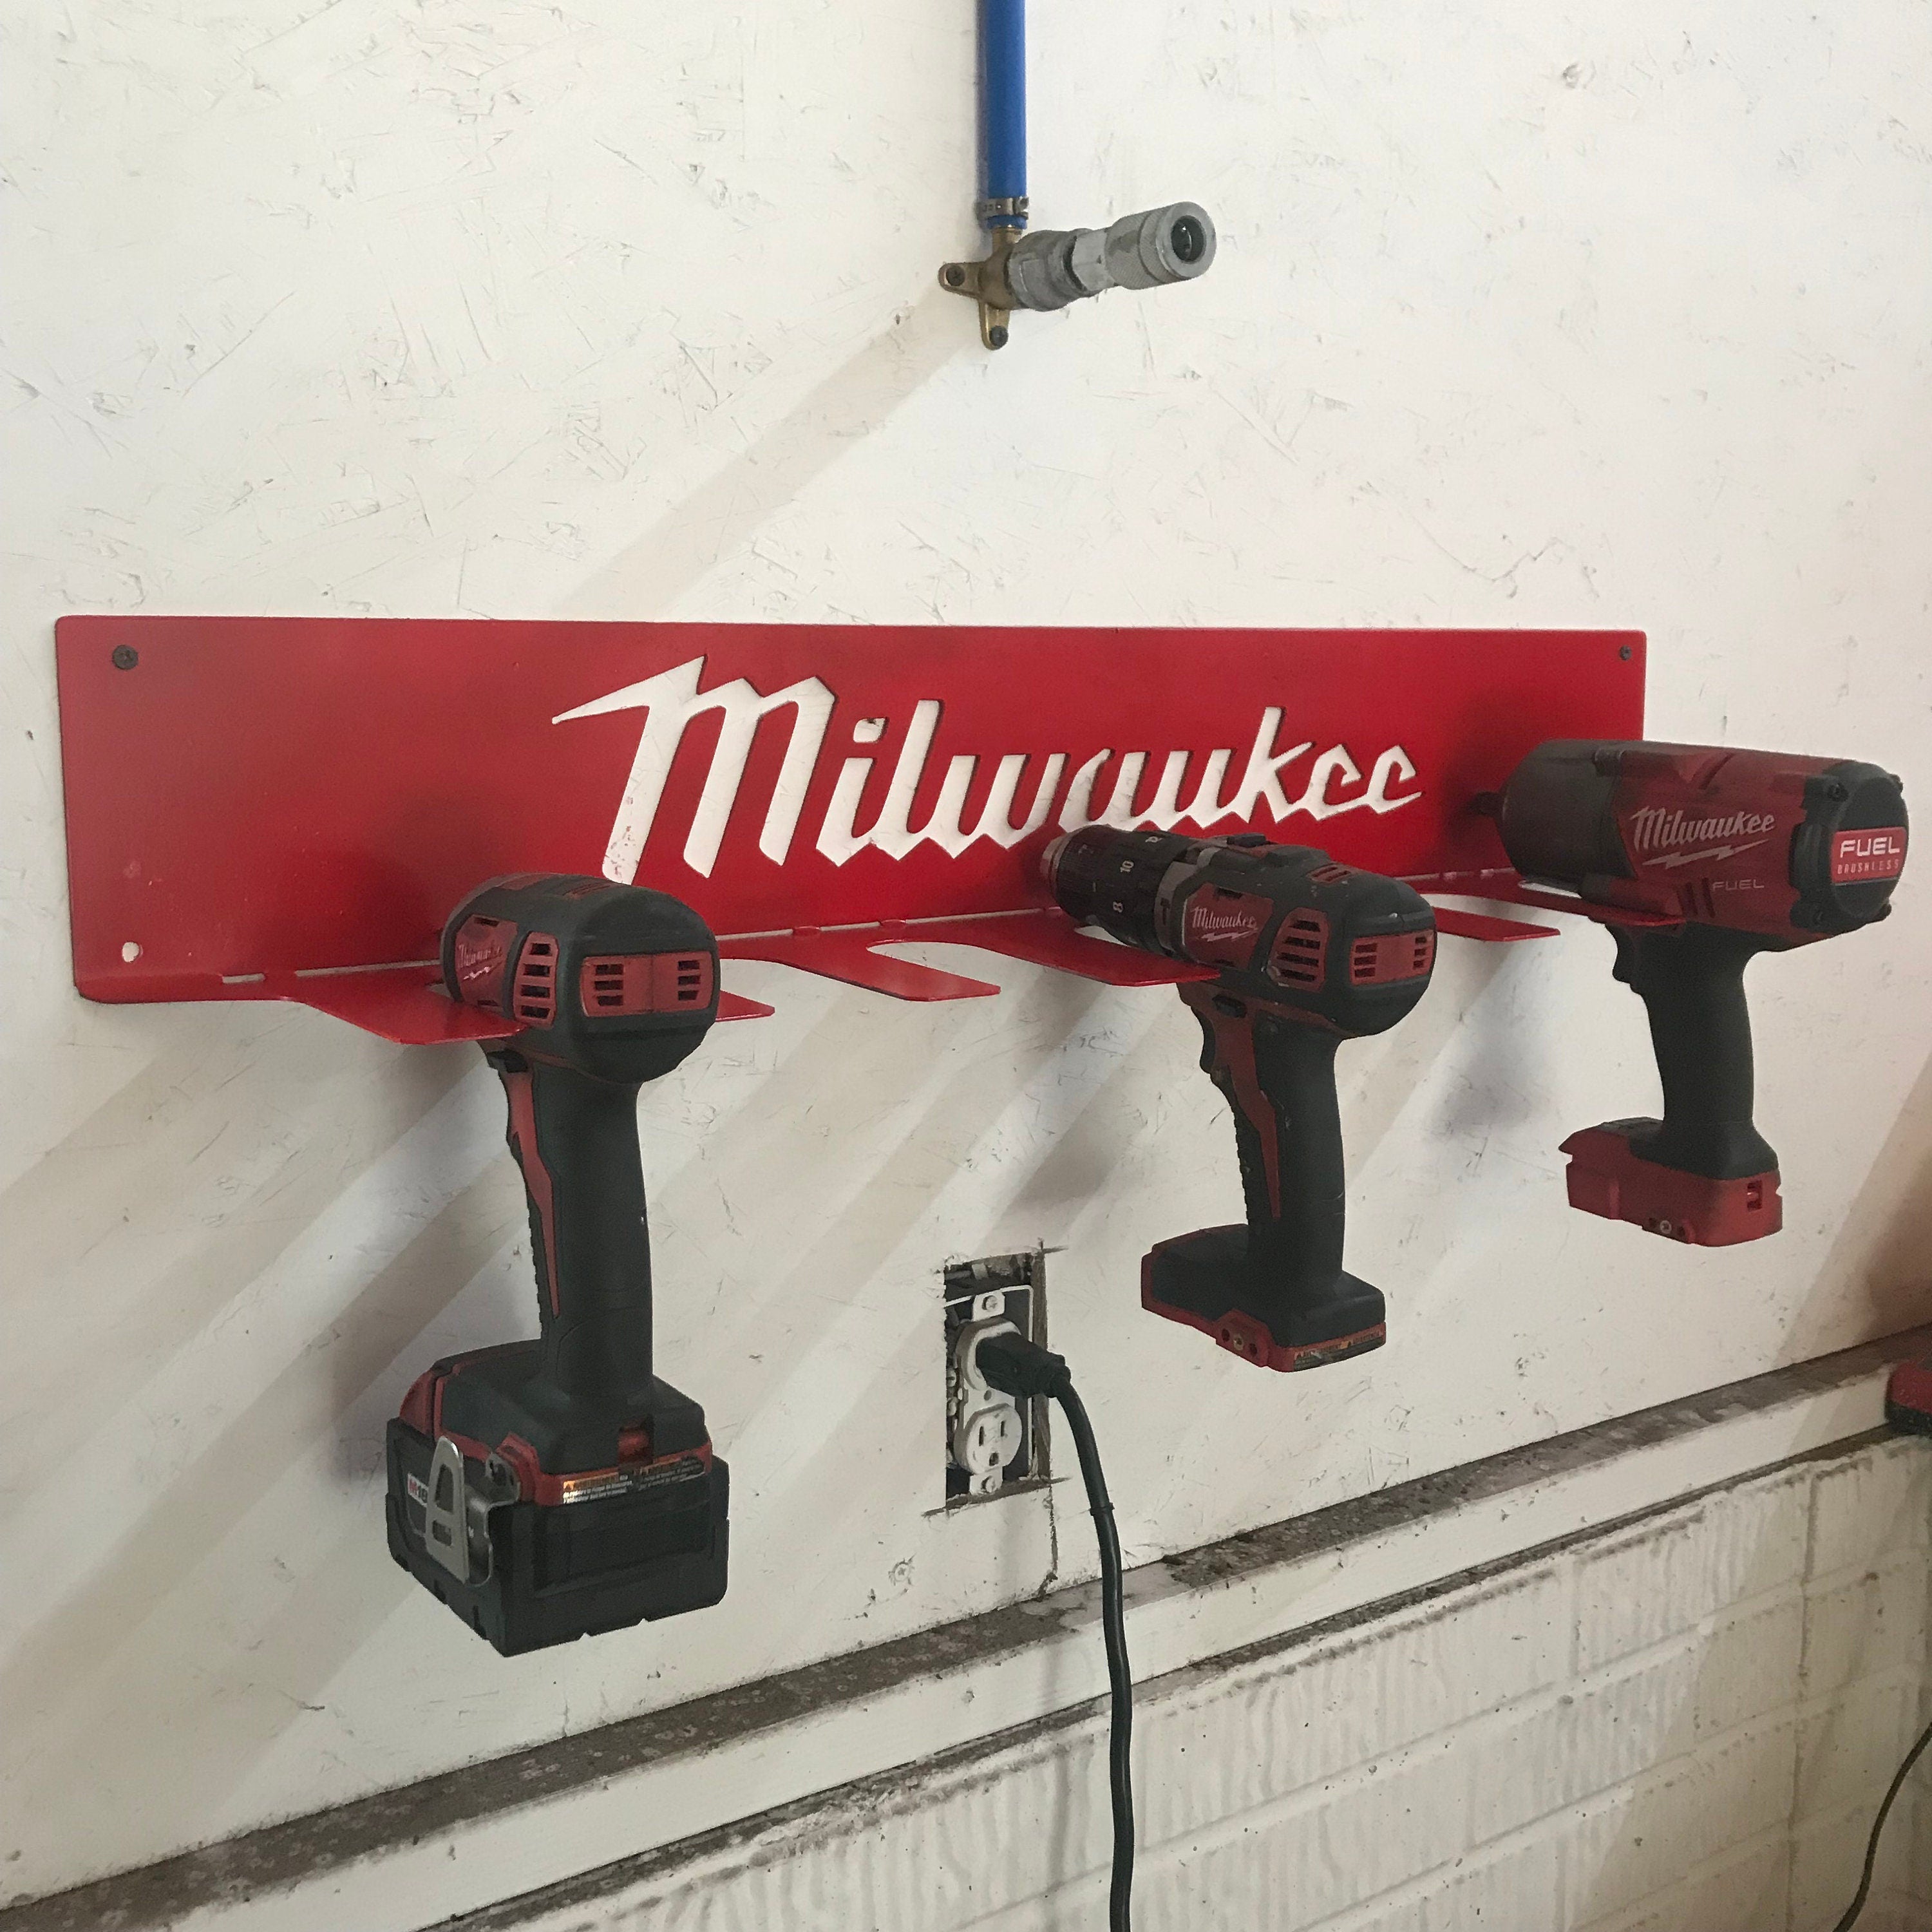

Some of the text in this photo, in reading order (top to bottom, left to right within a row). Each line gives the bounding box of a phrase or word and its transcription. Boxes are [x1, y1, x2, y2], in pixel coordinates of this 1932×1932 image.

[552, 656, 1422, 885] Milwaukee
[1630, 806, 1776, 852] Milwaukee
[1841, 837, 1900, 858] FUEL
[1120, 860, 1134, 873] 10
[1837, 859, 1899, 875] BRUSHLESS
[1712, 878, 1765, 892] FUEL
[1189, 906, 1258, 929] Milwaukee
